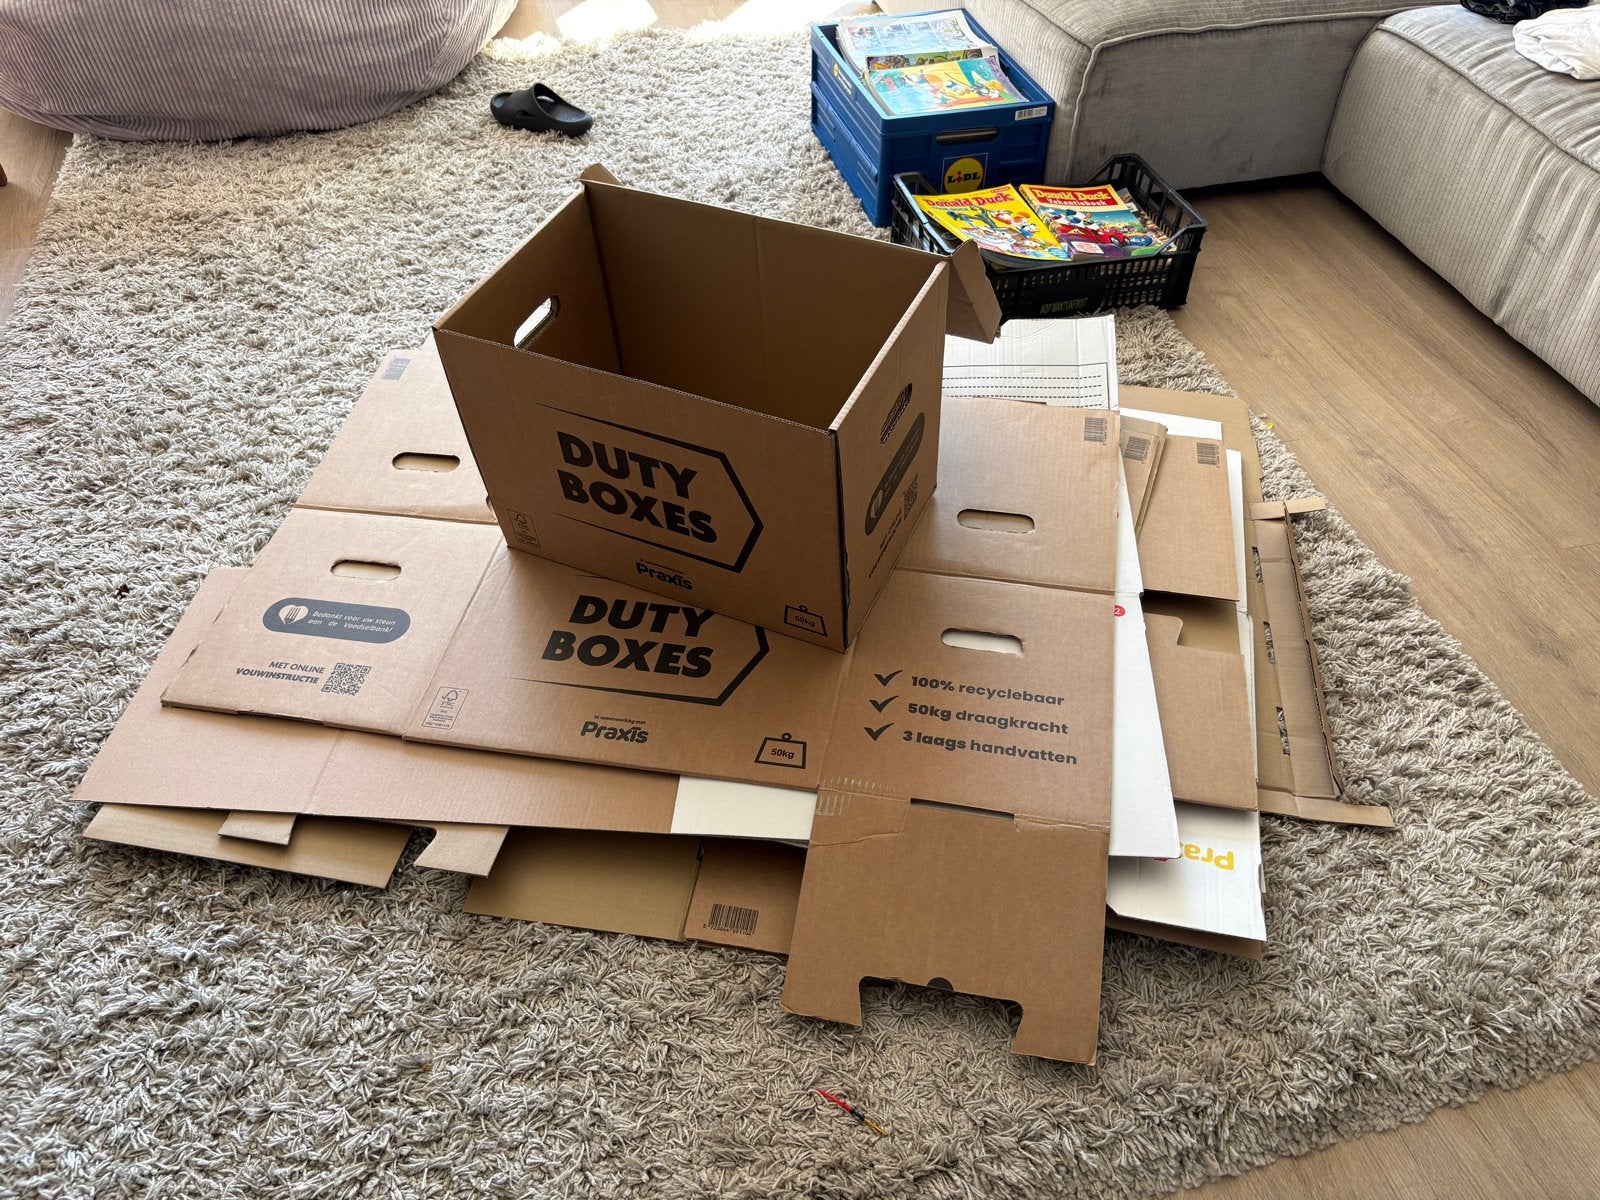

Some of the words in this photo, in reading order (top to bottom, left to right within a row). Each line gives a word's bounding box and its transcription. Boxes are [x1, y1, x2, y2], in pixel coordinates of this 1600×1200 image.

[923, 197, 974, 207] Donald
[973, 193, 1012, 206] Duck
[1032, 188, 1076, 200] Donald
[1076, 191, 1111, 201] Duck
[1047, 198, 1107, 206] Vakantieboek
[556, 431, 698, 499] DUTY
[557, 469, 717, 543] BOXES
[635, 562, 693, 590] Praxis
[312, 611, 342, 620] Bedankt
[344, 622, 393, 633] Voedselbank!
[568, 595, 716, 638] DUTY
[541, 631, 714, 678] BOXES
[235, 667, 320, 684] VOUWINSTRUCTIE
[269, 661, 289, 670] MET
[290, 663, 325, 674] ONLINE
[911, 676, 955, 692] 100%
[959, 682, 1065, 706] recyclebaar
[908, 703, 952, 721] 50kg
[955, 709, 1069, 734] draagkracht
[580, 720, 649, 743] Praxis
[770, 746, 795, 760] 50kg
[902, 730, 913, 742] 3
[916, 732, 967, 752] laags
[970, 739, 1078, 765] handvatten
[1180, 842, 1234, 870] Pra
